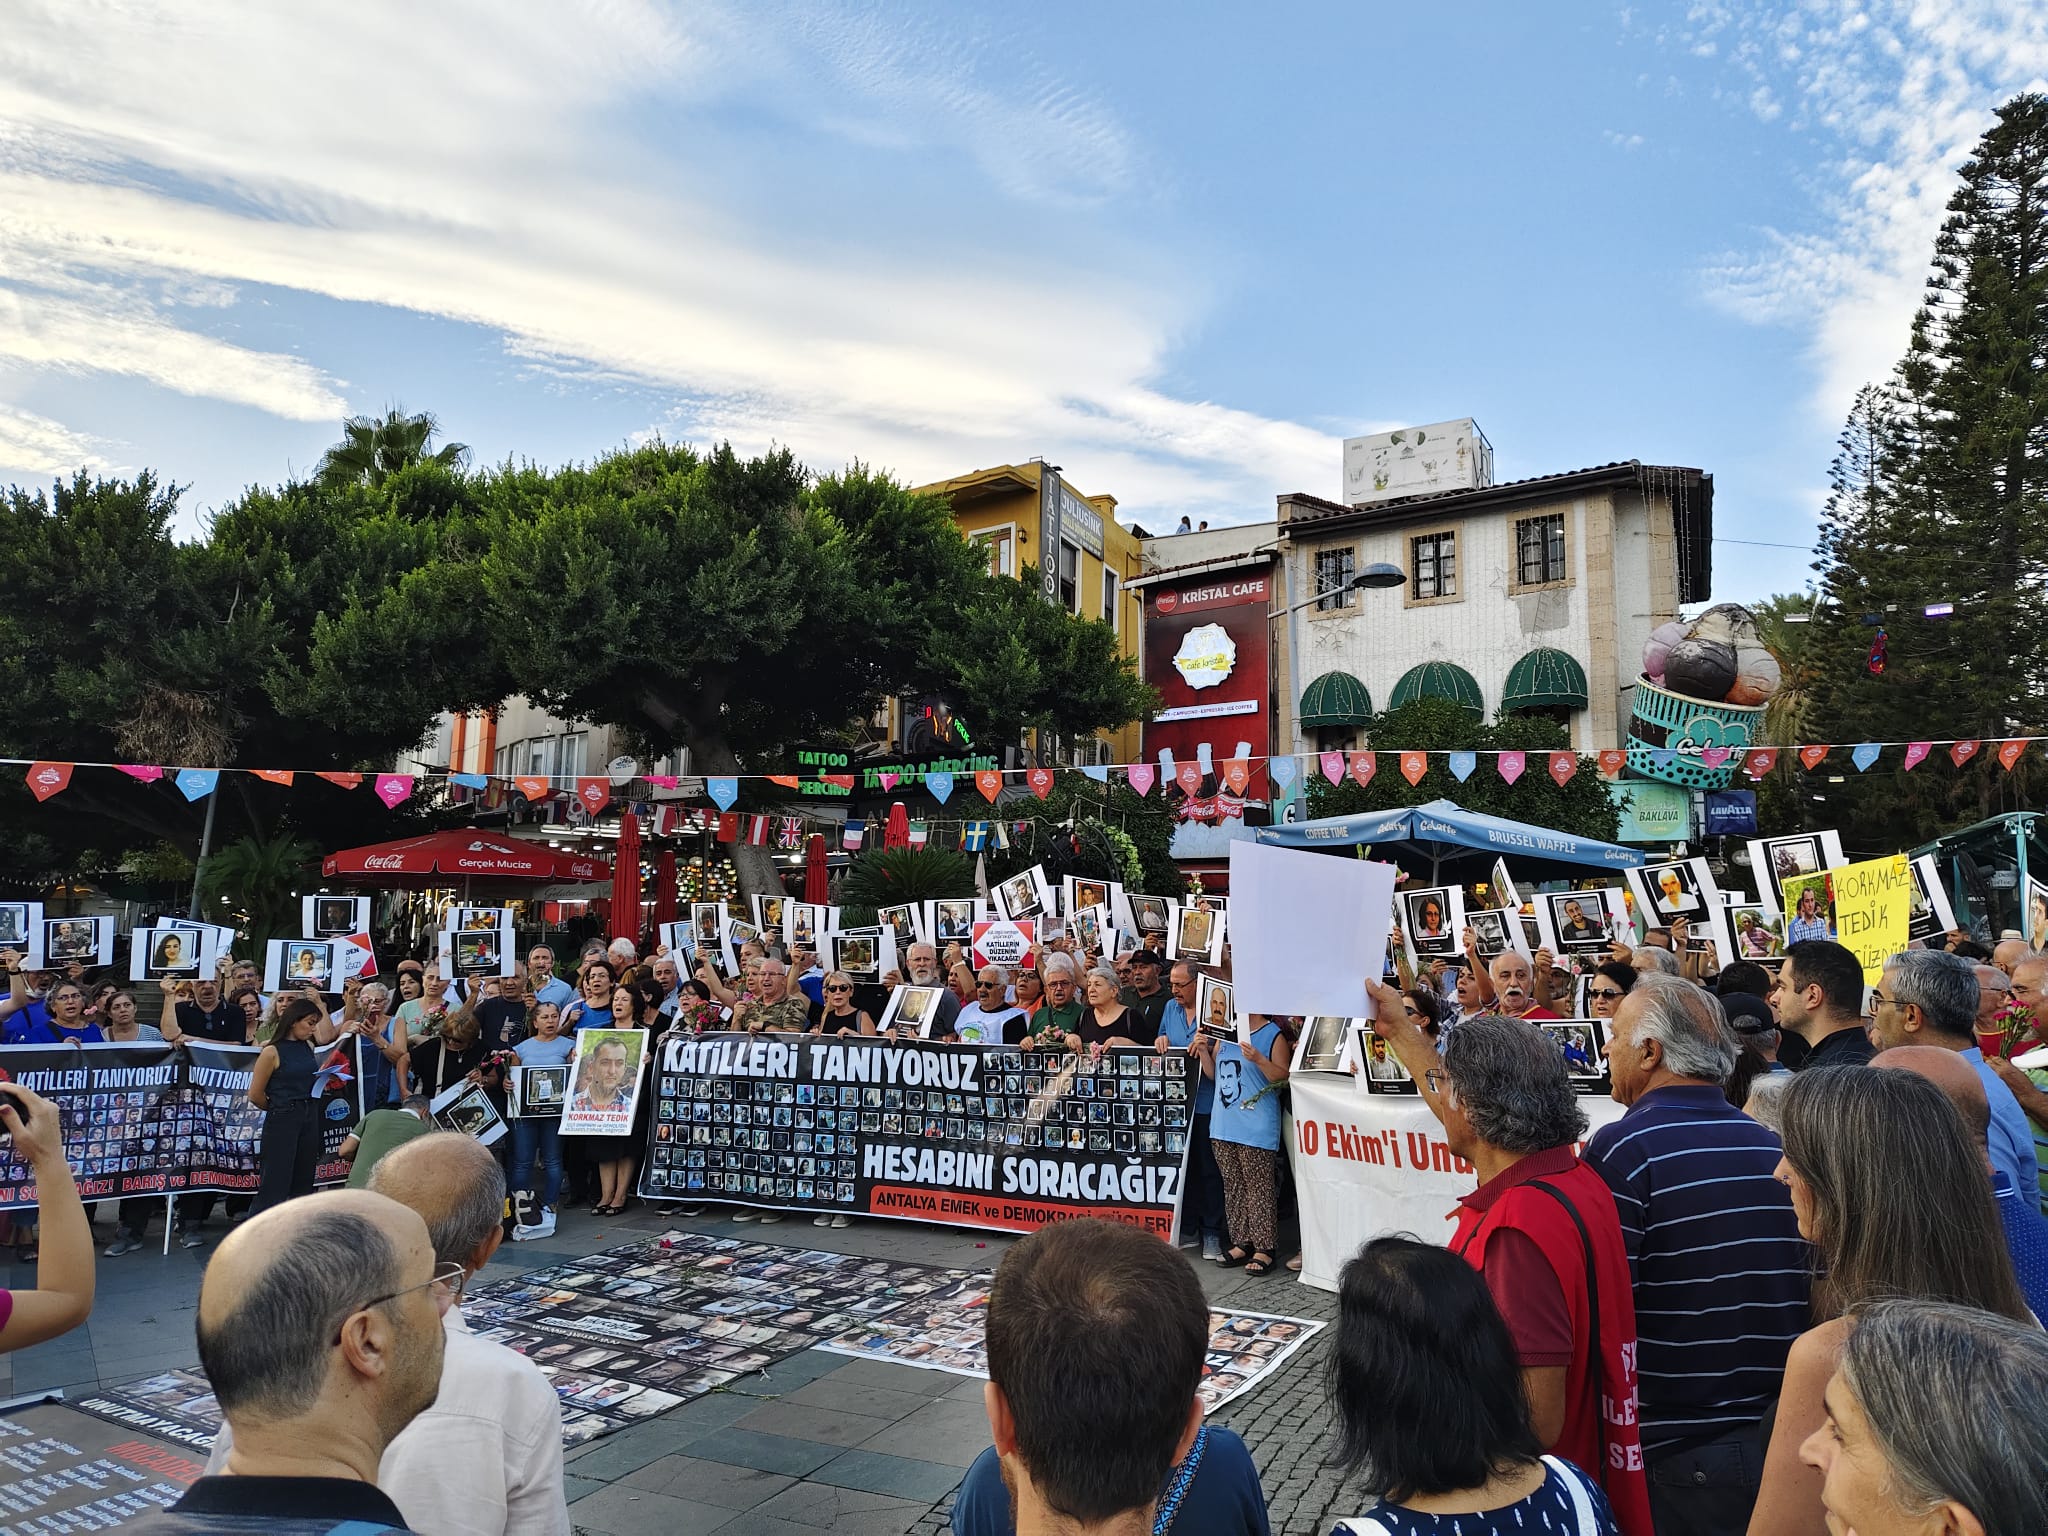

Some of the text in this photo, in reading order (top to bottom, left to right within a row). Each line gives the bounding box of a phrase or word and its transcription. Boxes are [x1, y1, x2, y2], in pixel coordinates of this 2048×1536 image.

[1182, 581, 1264, 604] KRİSTAL CAFE
[1186, 661, 1201, 670] cafe
[796, 751, 848, 767] TATTOO
[917, 762, 927, 783] &
[1639, 811, 1679, 822] BAKLAVA
[1711, 804, 1752, 815] LAVAZZA
[1305, 825, 1349, 840] COFFEE TIME
[1488, 829, 1576, 854] BRUSSEL WAFFLE
[458, 858, 532, 869] Gerçek Mucize
[1836, 862, 1910, 902] KORKMAZ
[1838, 899, 1889, 937] TEDİK
[662, 1038, 979, 1092] KATİLLERİ TANIYORUZ
[16, 1066, 88, 1092] KATİLLERİ
[92, 1064, 178, 1089] TANIYORUZ!
[568, 1112, 629, 1122] KORKMAZ TEDİK
[1296, 1119, 1319, 1156] 10
[1325, 1122, 1402, 1169] Ekim'i
[122, 1173, 166, 1192] BARIŞ
[169, 1175, 186, 1187] ve
[863, 1144, 1178, 1204] HESABINI SORACAĞIZ
[876, 1191, 937, 1211] ANTALYA
[940, 1197, 980, 1216] EMEK
[983, 1205, 1000, 1218] ve
